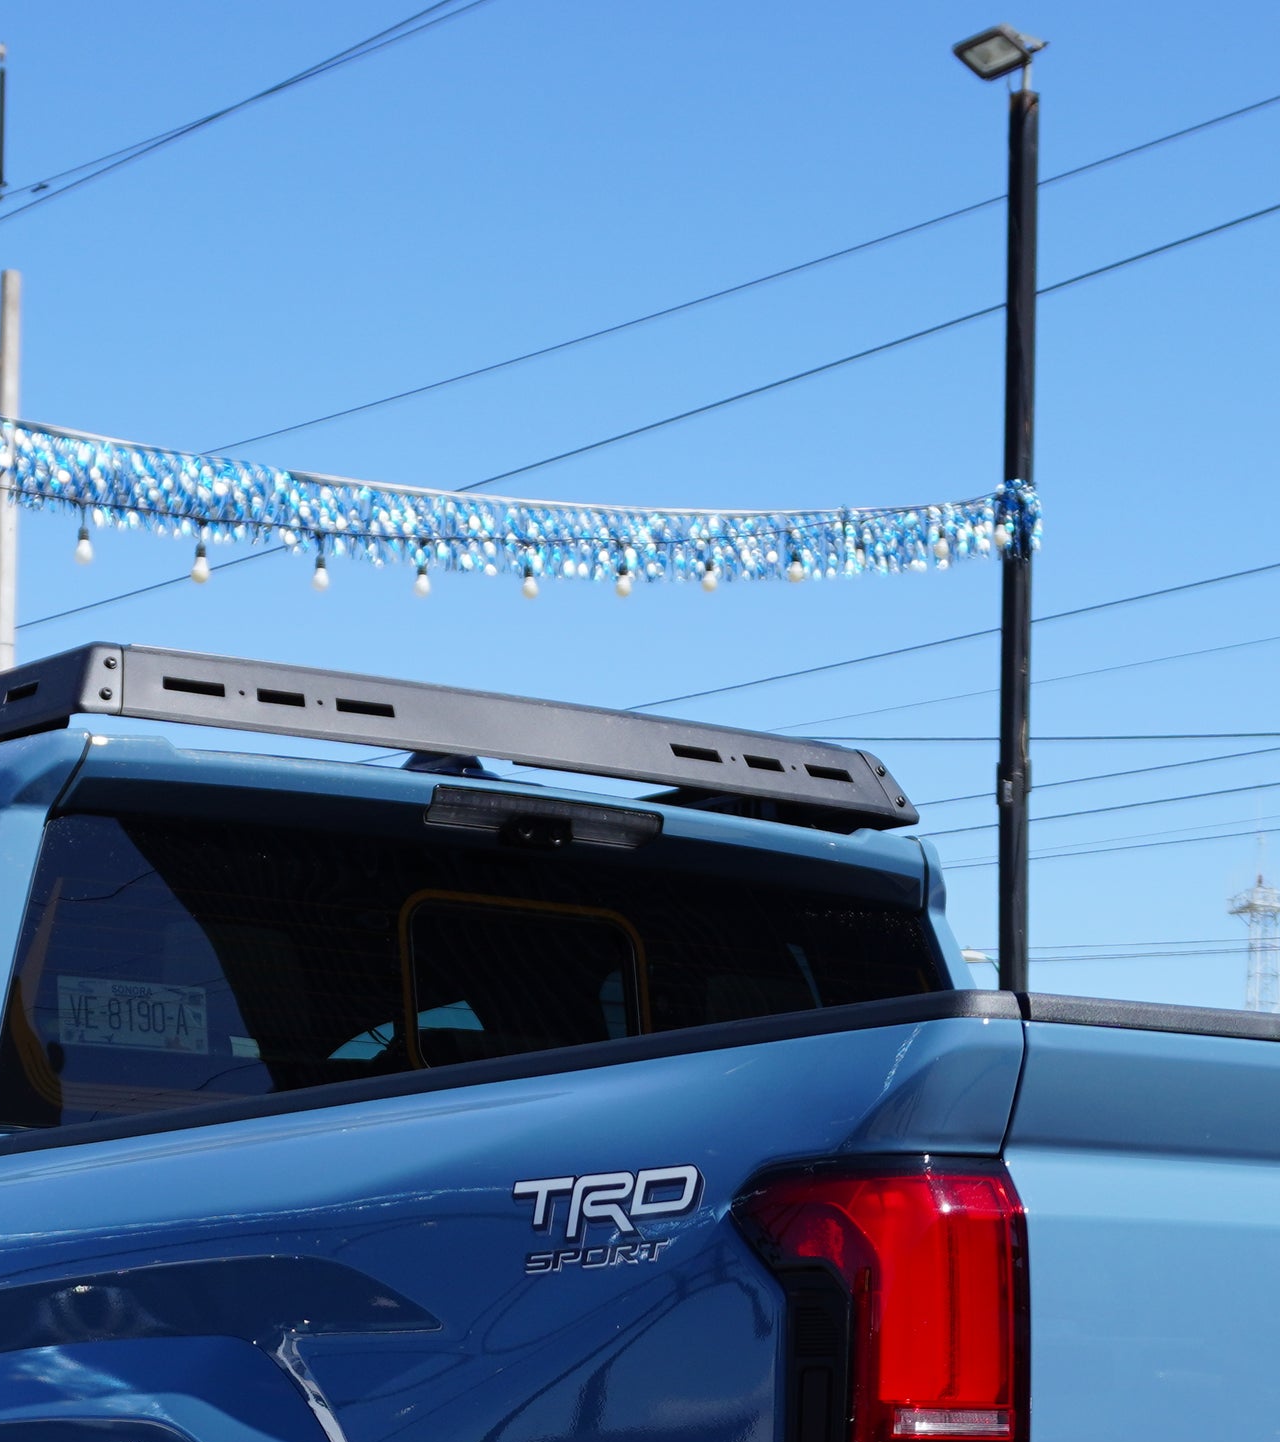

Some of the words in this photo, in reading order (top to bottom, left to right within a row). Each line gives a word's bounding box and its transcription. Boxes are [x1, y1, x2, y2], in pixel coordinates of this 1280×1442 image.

[111, 983, 153, 998] SONORA
[69, 994, 190, 1036] VE-8190-A
[512, 1164, 703, 1242] TRD
[524, 1238, 675, 1274] SPORT
